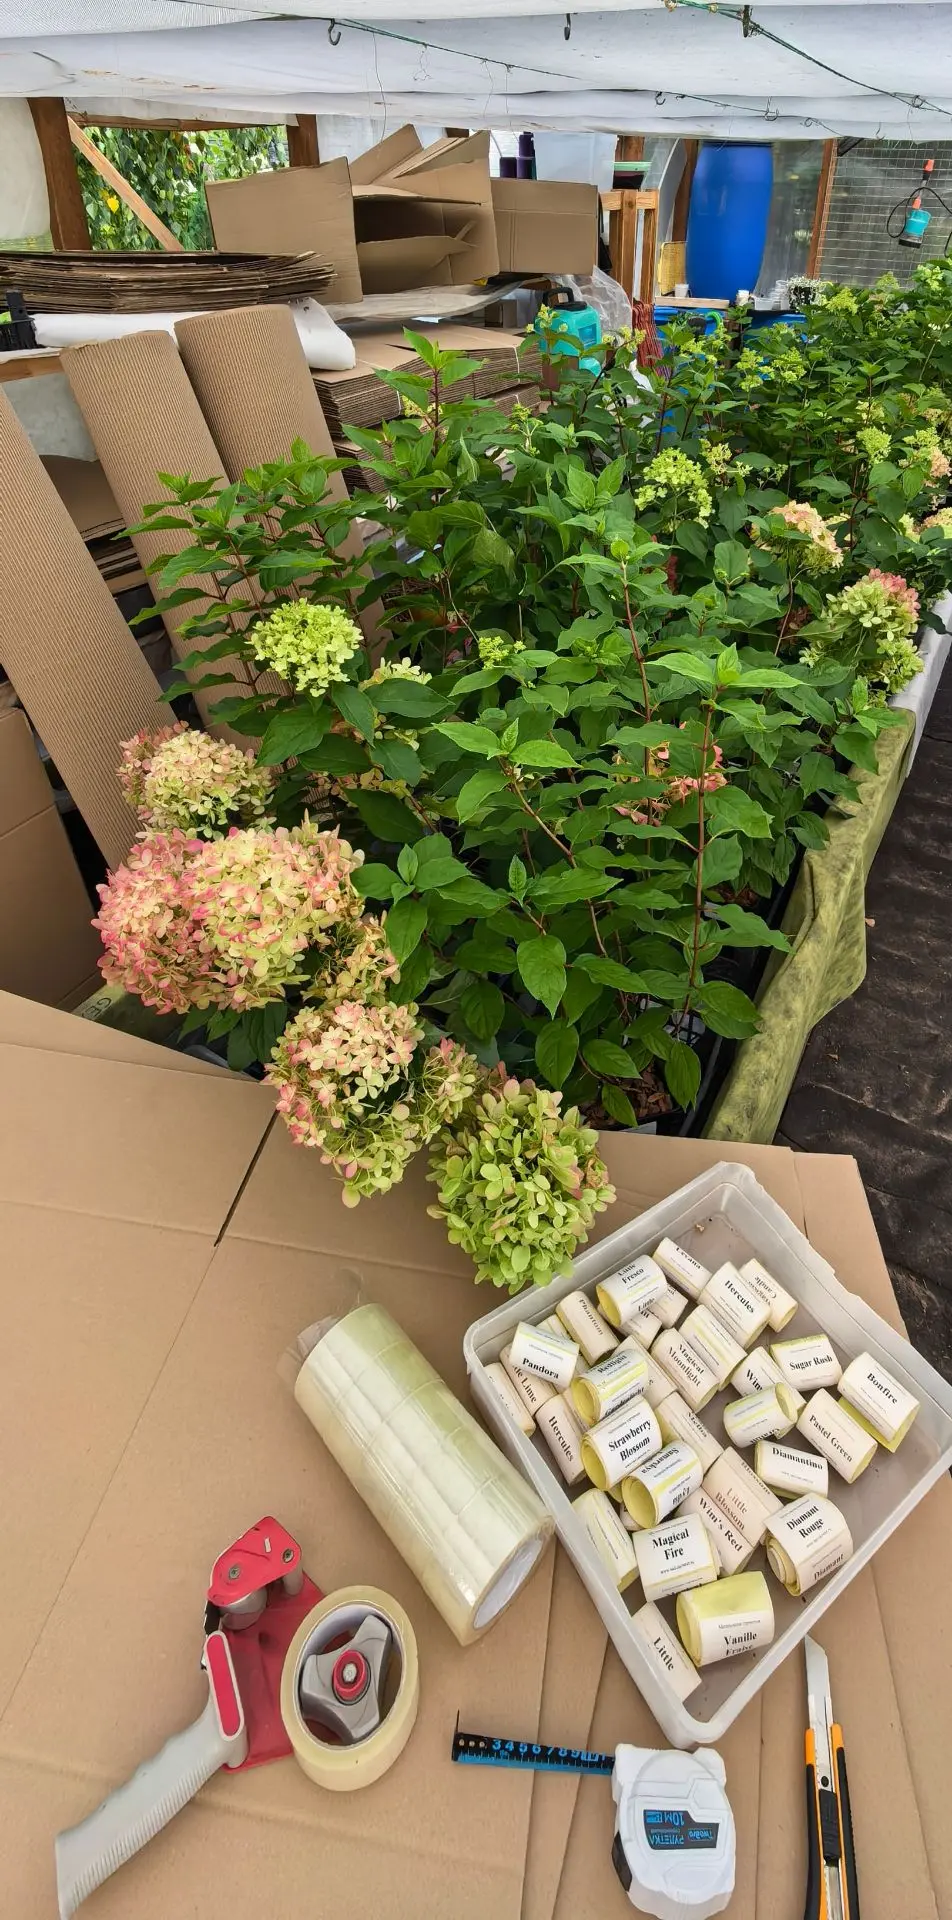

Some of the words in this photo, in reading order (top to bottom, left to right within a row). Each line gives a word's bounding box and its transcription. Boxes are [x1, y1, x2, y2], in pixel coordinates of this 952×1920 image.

[82, 997, 112, 1018] GE
[621, 1268, 645, 1284] Fresco
[755, 1276, 777, 1299] Candle
[724, 1280, 754, 1313] Hercules
[580, 1298, 604, 1336] Phantom
[522, 1358, 559, 1380] Pandora
[668, 1346, 701, 1387] Moonlight
[679, 1343, 705, 1375] Magical
[789, 1360, 812, 1370] Sugar
[814, 1354, 833, 1366] Rush
[521, 1377, 537, 1404] Lime
[867, 1372, 898, 1405] Bonfire
[548, 1415, 575, 1462] Hercules
[608, 1419, 652, 1452] Strawberry
[619, 1436, 650, 1461] Blossom
[809, 1414, 832, 1440] Pastel
[830, 1437, 853, 1463] Green
[772, 1446, 823, 1470] Diamantino
[715, 1491, 745, 1531] Blossom
[726, 1487, 748, 1515] Little
[699, 1496, 723, 1531] Wim's
[724, 1529, 743, 1552] Red
[786, 1505, 820, 1530] Diamant
[798, 1518, 824, 1538] Rouge
[652, 1528, 690, 1549] Magical
[664, 1547, 685, 1560] Fire
[813, 1553, 845, 1581] Diamant
[724, 1631, 757, 1646] Vanille
[653, 1636, 674, 1671] Little
